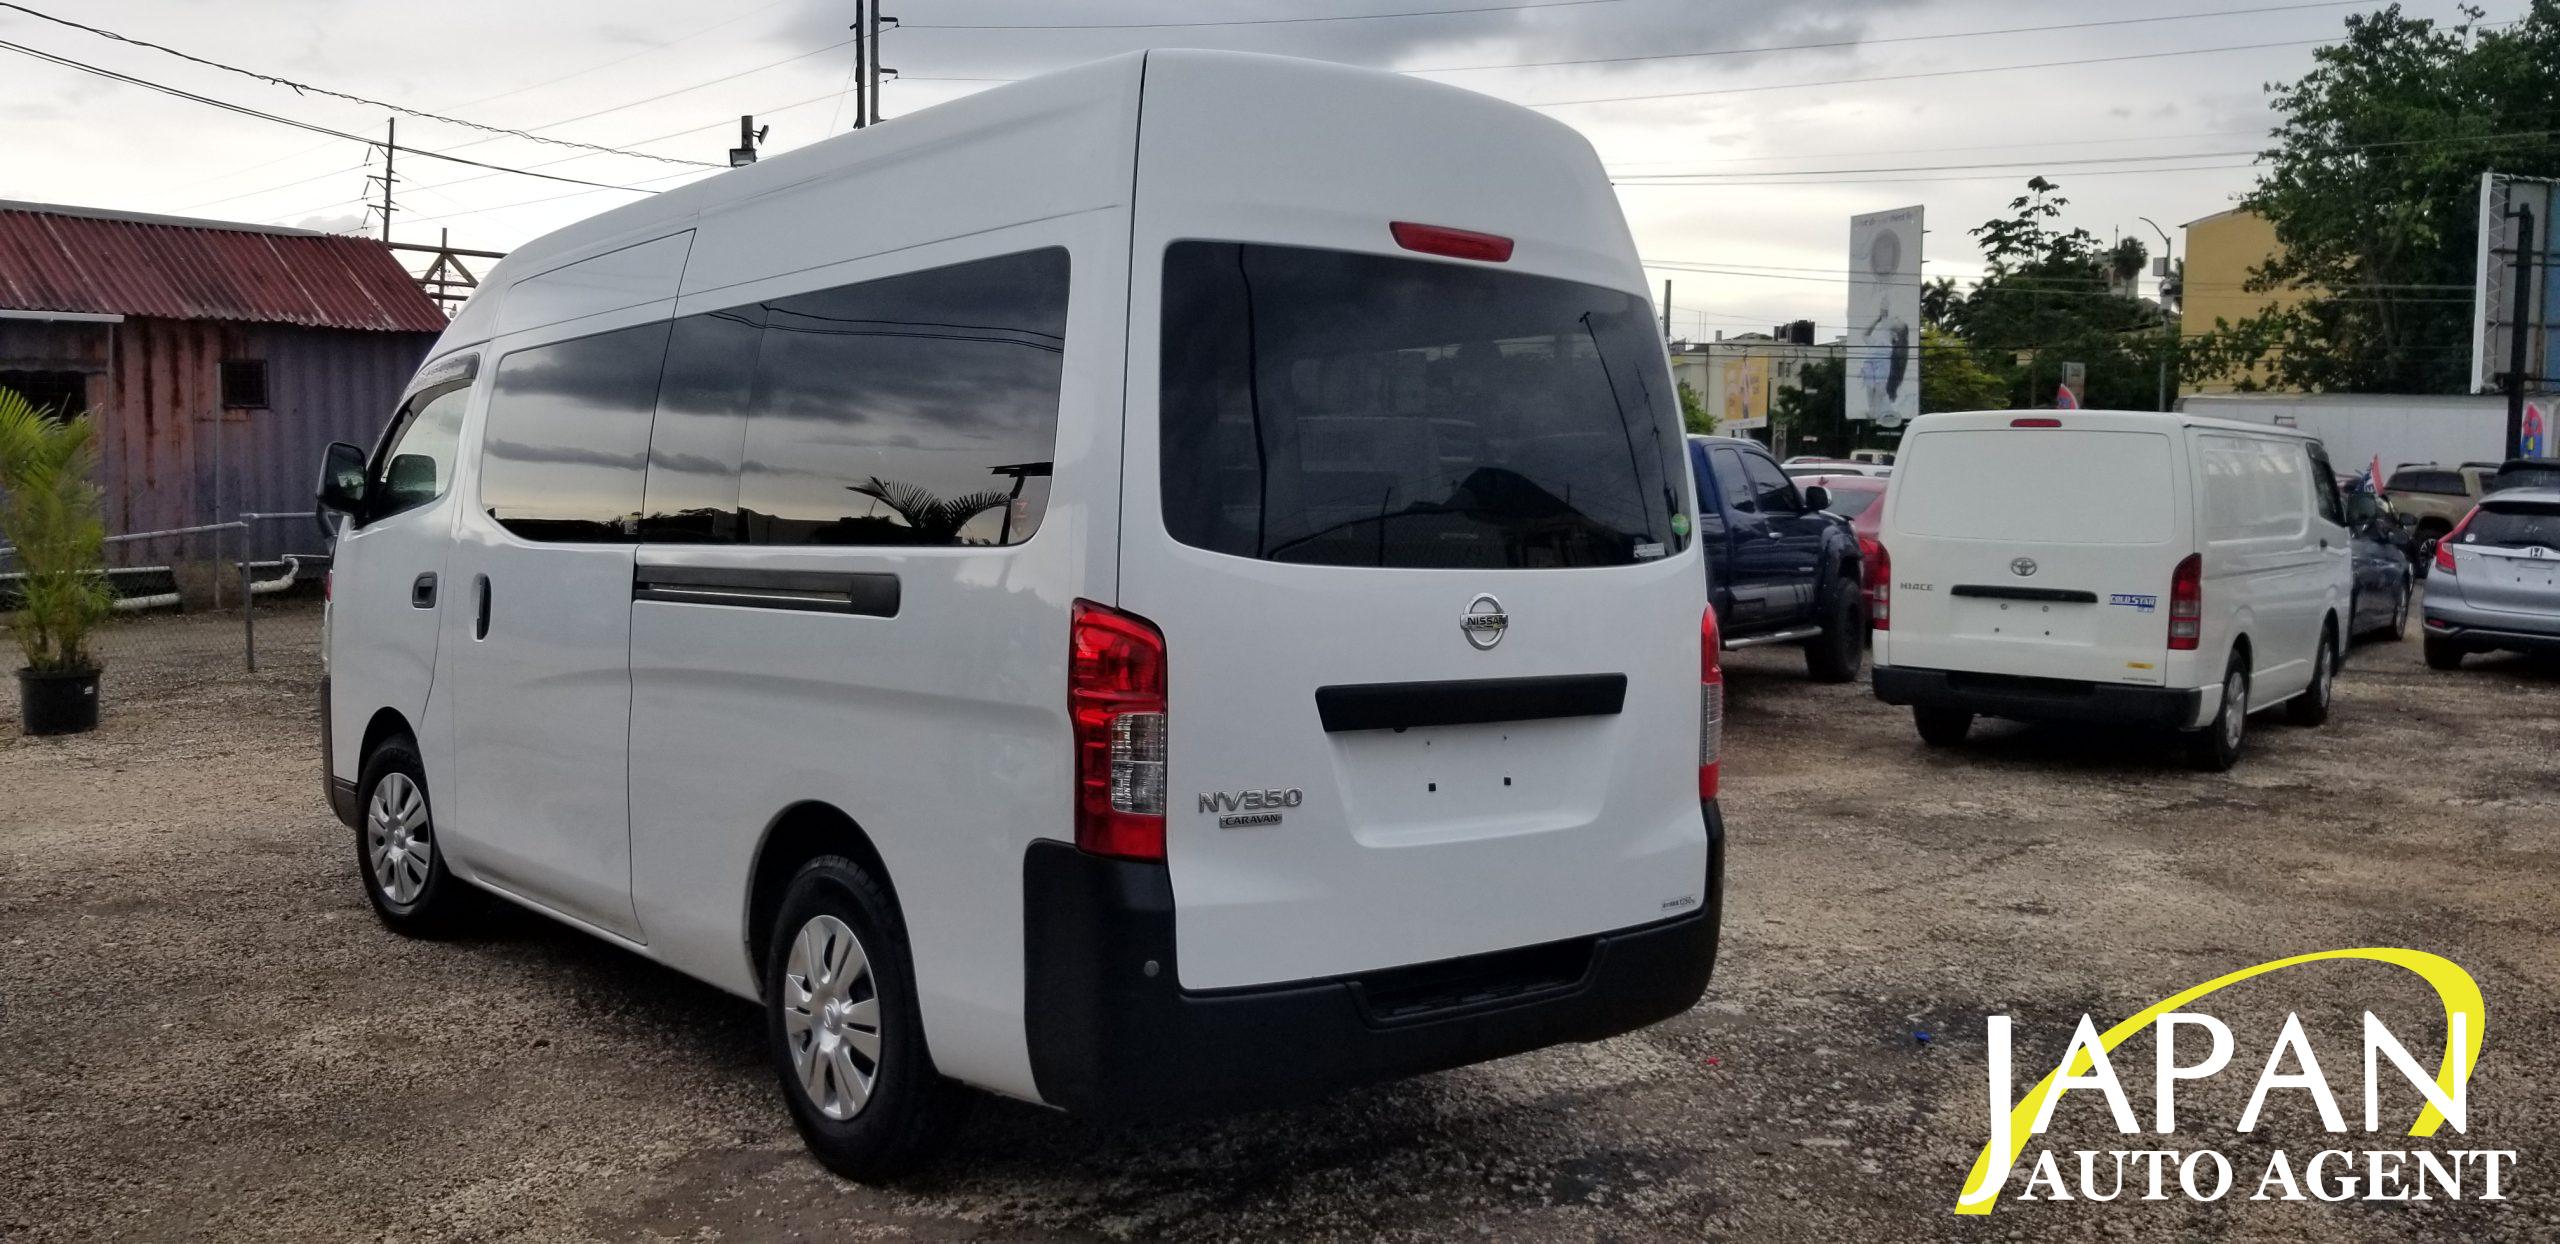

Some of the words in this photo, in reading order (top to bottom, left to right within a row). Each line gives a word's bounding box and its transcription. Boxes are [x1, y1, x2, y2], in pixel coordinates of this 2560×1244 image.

[1900, 582, 1936, 591] HIACE
[1467, 616, 1507, 625] NISSAN
[1198, 787, 1303, 813] NV350
[1225, 814, 1279, 825] CARAVAN
